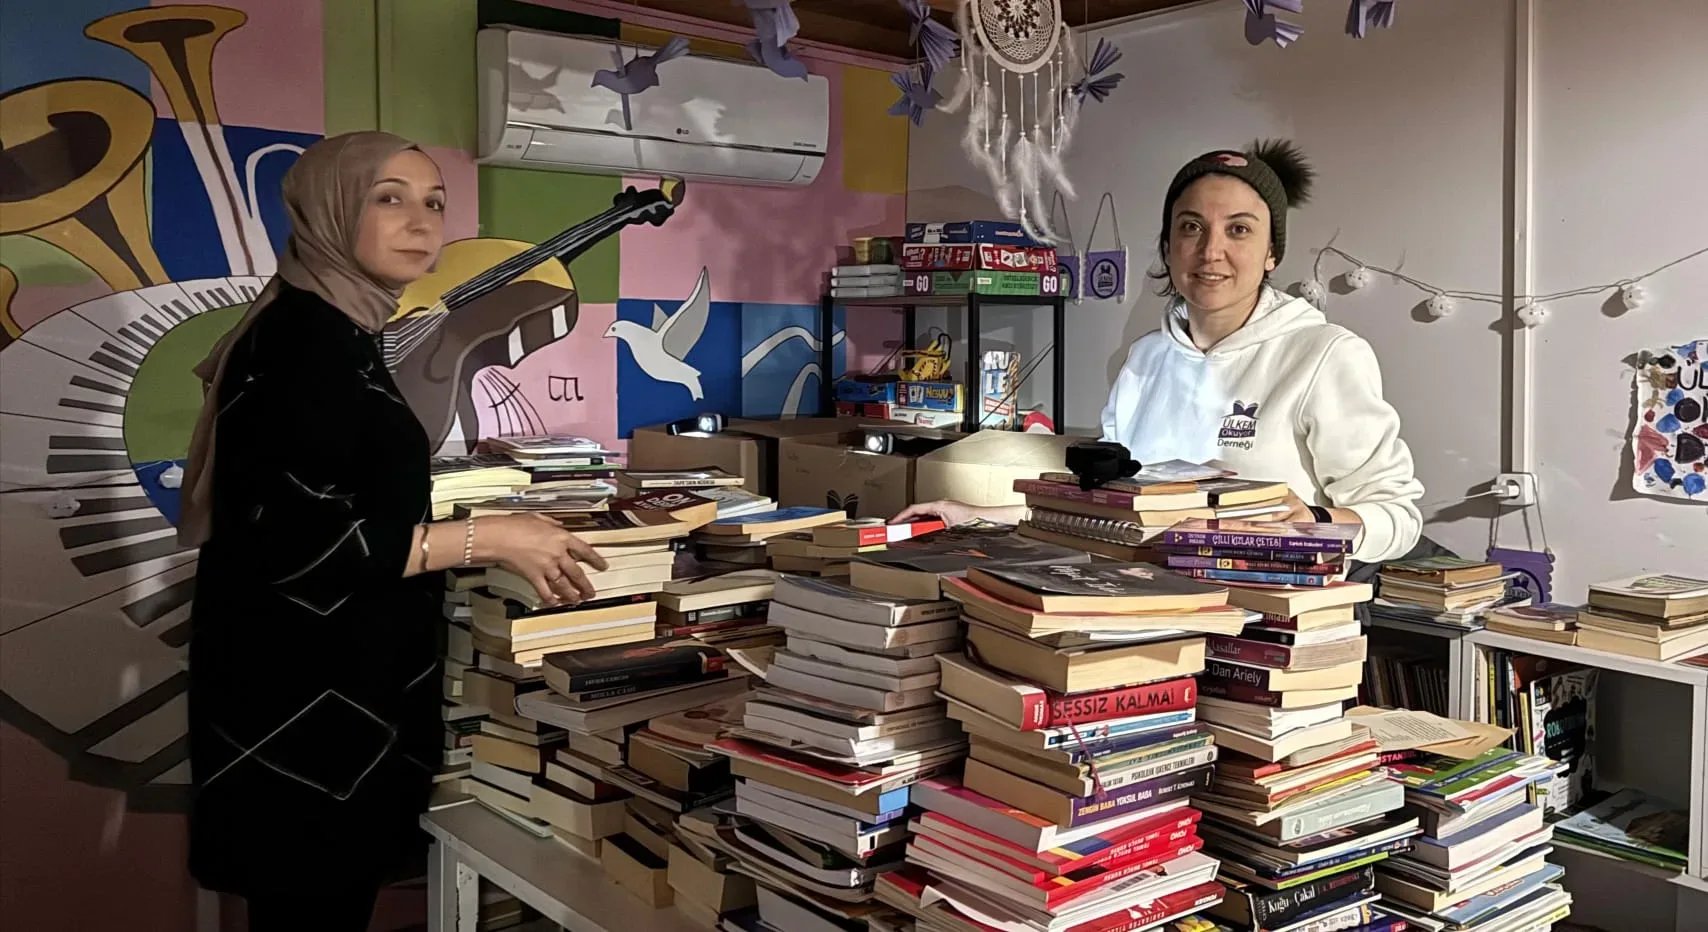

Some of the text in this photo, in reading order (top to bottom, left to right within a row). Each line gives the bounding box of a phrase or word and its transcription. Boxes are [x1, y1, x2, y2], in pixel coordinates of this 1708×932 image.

[916, 275, 929, 292] GO
[1042, 275, 1058, 293] GO
[1223, 416, 1257, 430] ÜLKEM
[1217, 438, 1254, 451] Derneği
[1211, 640, 1241, 655] asallar
[1212, 663, 1262, 686] Dan Ariely
[1115, 688, 1175, 713] KALMA!
[1100, 800, 1116, 811] BABA
[1116, 795, 1137, 808] YOKSUL
[1137, 790, 1153, 801] BABA
[1267, 884, 1316, 914] Kuğu Çakal
